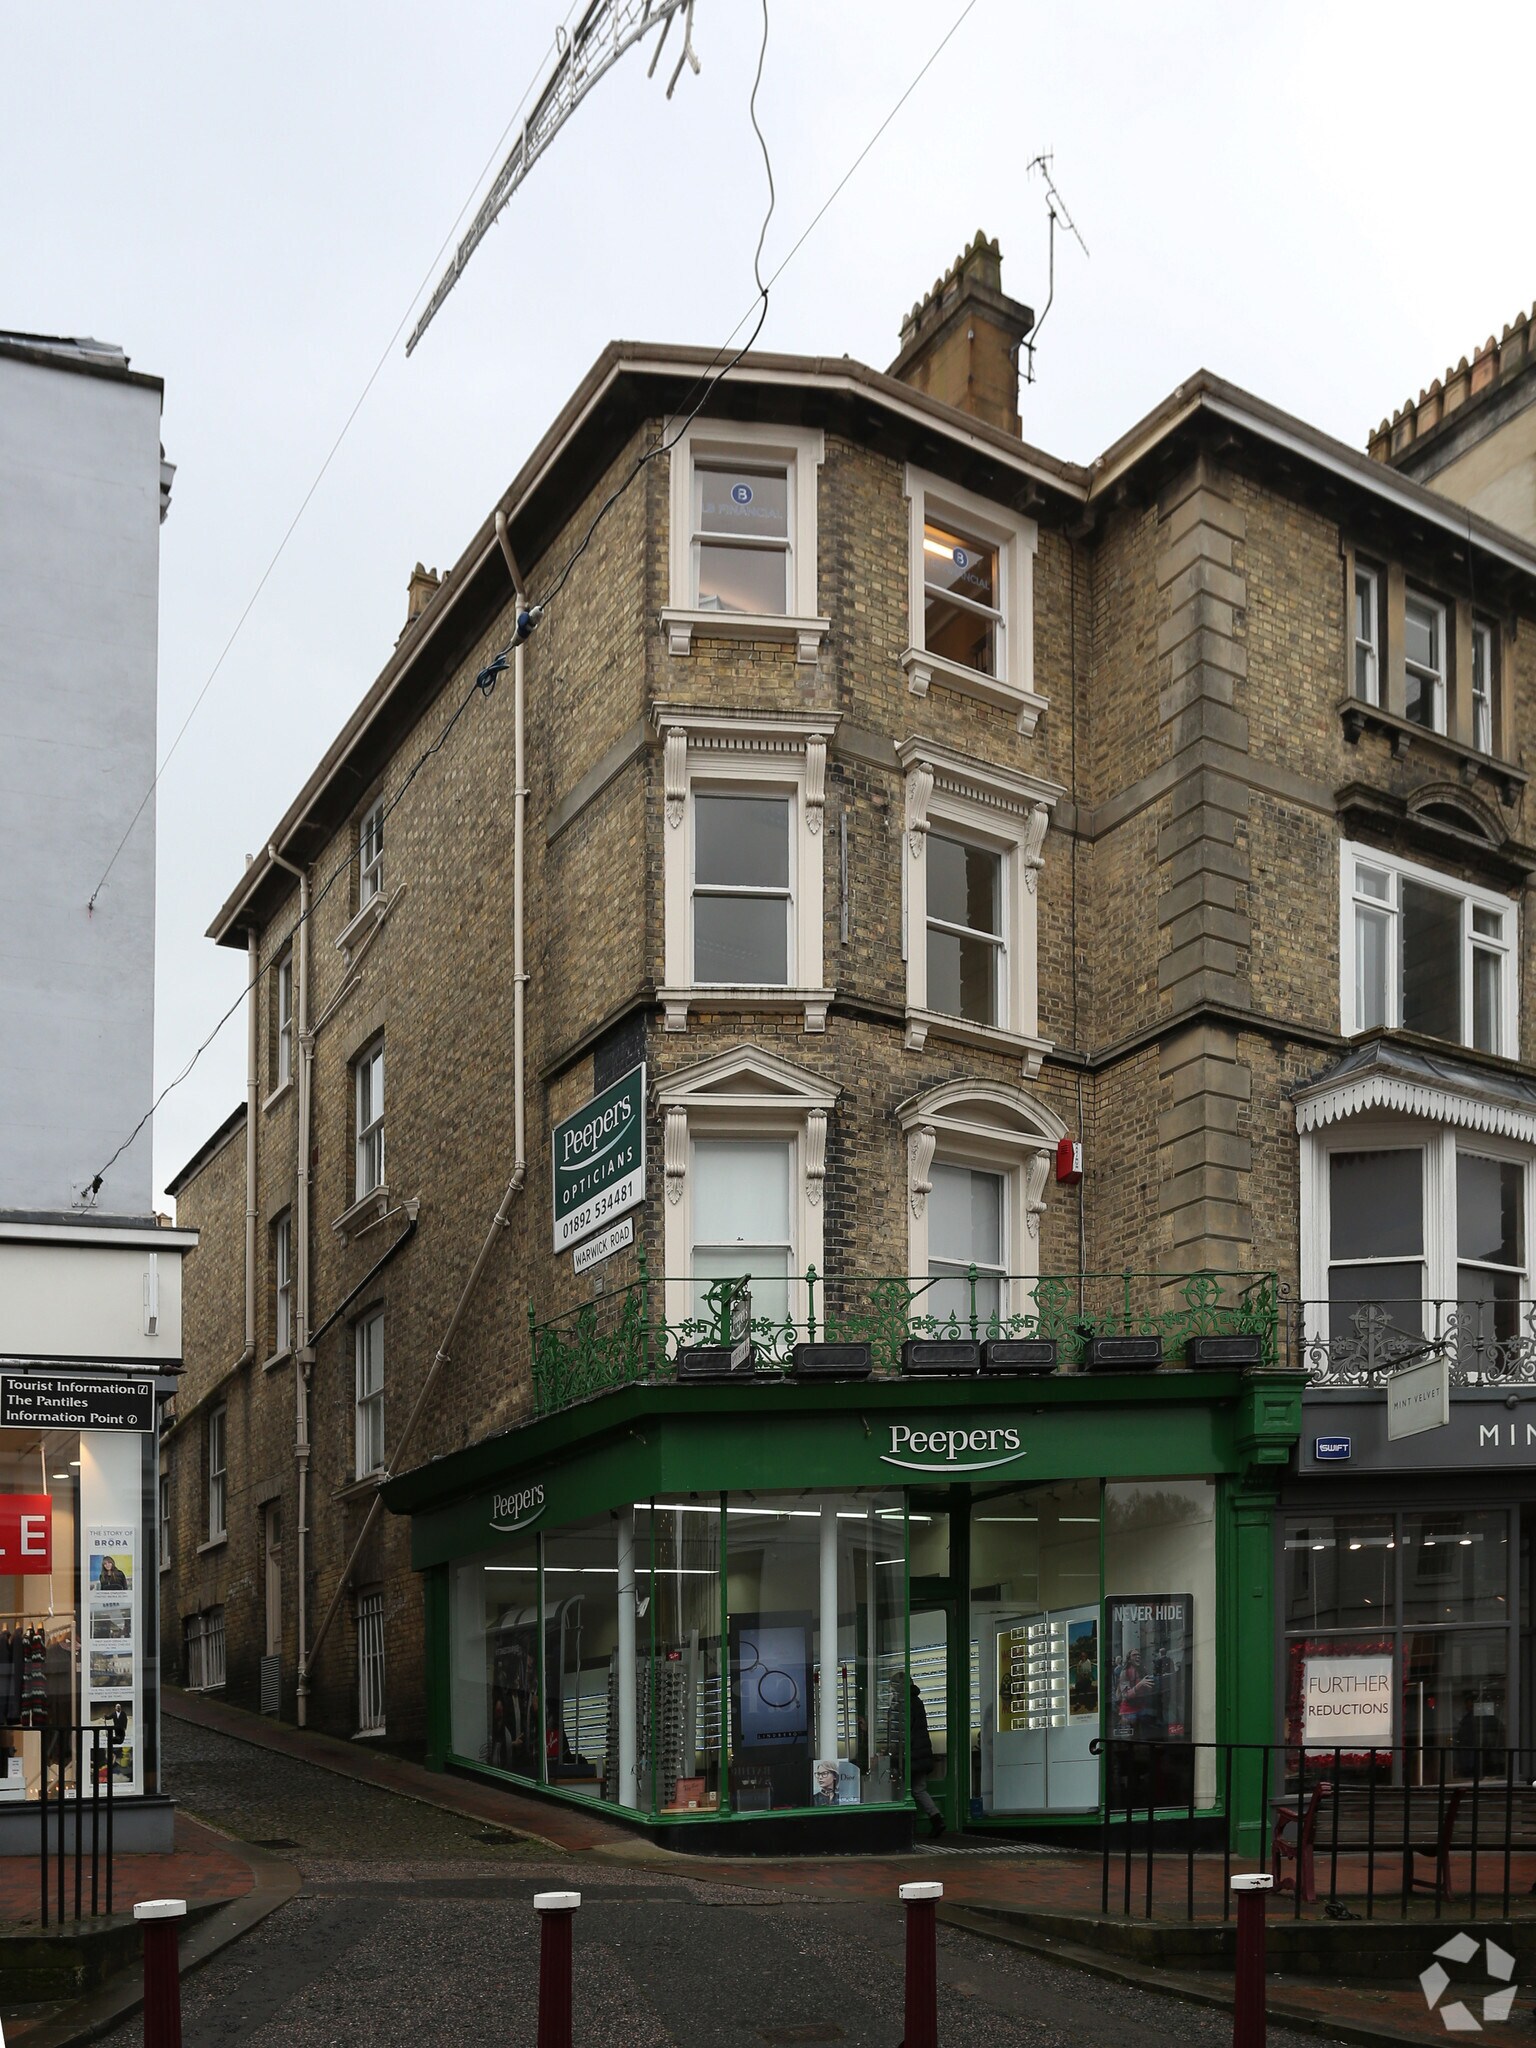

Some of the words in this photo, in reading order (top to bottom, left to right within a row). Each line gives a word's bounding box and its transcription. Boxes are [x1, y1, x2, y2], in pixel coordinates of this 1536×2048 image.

[738, 488, 748, 501] B
[563, 1094, 632, 1163] Peepers
[563, 1146, 633, 1205] OPTICIANS
[562, 1208, 591, 1239] 01892
[595, 1180, 633, 1219] 534481
[575, 1239, 608, 1267] WARWICK
[610, 1226, 630, 1248] ROAD
[6, 1379, 54, 1392] Tourist
[57, 1381, 136, 1395] Information
[1394, 1397, 1412, 1410] MINT
[1415, 1387, 1440, 1403] VELVET
[6, 1394, 33, 1406] The
[36, 1395, 89, 1408] Pantiles
[6, 1410, 86, 1423] Information
[90, 1412, 124, 1424] Point
[888, 1425, 1021, 1460] Peepers
[493, 1484, 545, 1520] Peepers
[0, 1515, 46, 1556] E
[1114, 1605, 1153, 1621] NEVER
[1155, 1605, 1183, 1621] HIDE
[1309, 1675, 1389, 1694] FURTHER
[1308, 1702, 1389, 1716] REDUCTIONS
